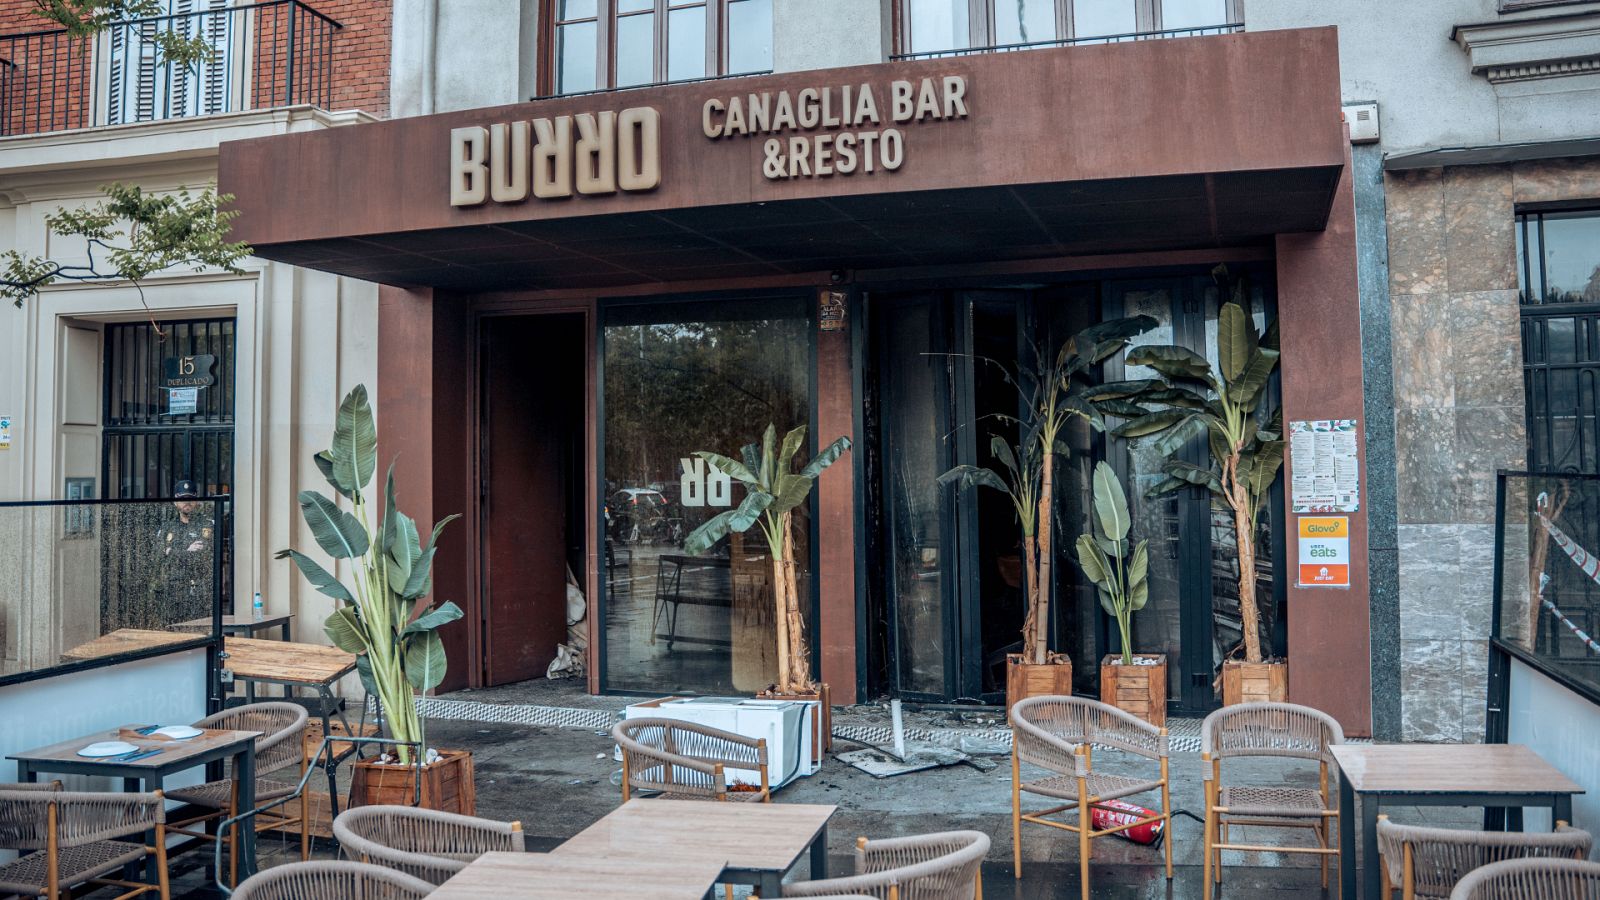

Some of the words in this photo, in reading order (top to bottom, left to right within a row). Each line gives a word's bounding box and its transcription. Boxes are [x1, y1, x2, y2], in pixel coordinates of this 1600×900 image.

[702, 86, 880, 140] CANAGLIA
[892, 75, 970, 122] BAR
[450, 105, 662, 207] BURRO
[763, 128, 904, 180] &RESTO
[179, 356, 195, 375] 15
[167, 376, 209, 386] DUPLICADO
[1307, 524, 1337, 533] Glovo
[1310, 548, 1337, 557] eats
